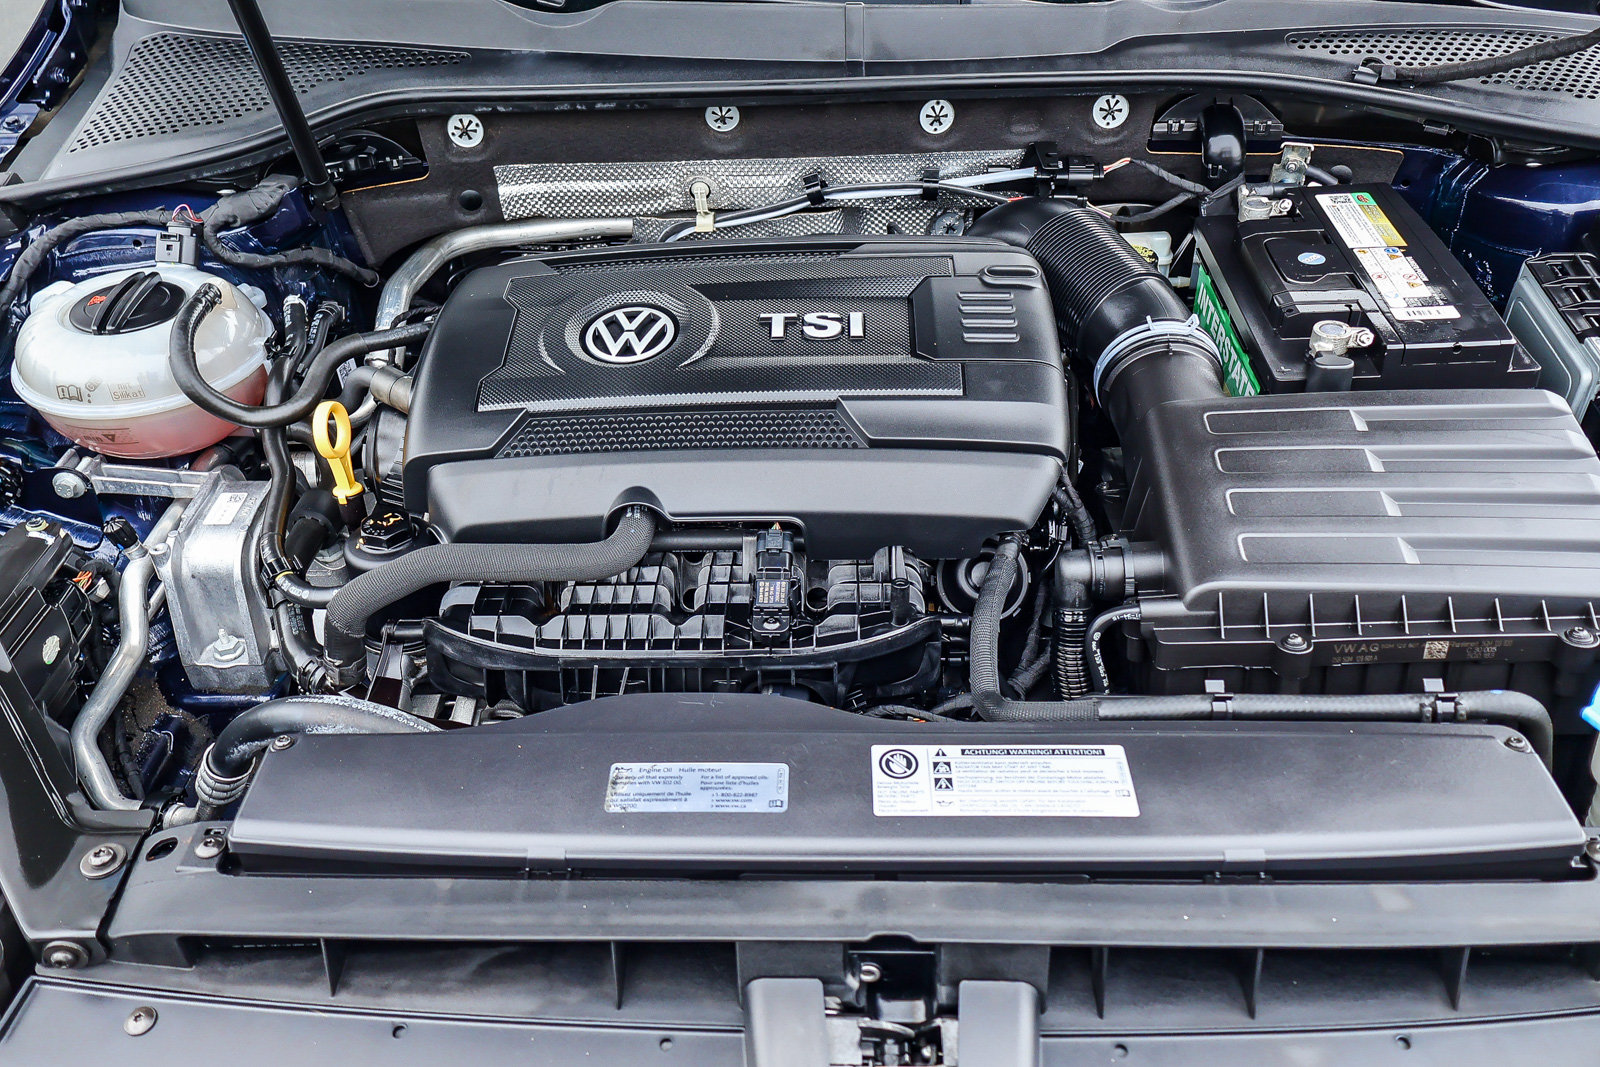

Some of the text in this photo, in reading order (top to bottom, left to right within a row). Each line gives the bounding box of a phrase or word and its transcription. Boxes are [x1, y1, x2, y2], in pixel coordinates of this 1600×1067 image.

[759, 312, 865, 340] TSI
[112, 390, 144, 400] Silikat
[1334, 644, 1357, 654] VW
[1358, 643, 1380, 652] AG
